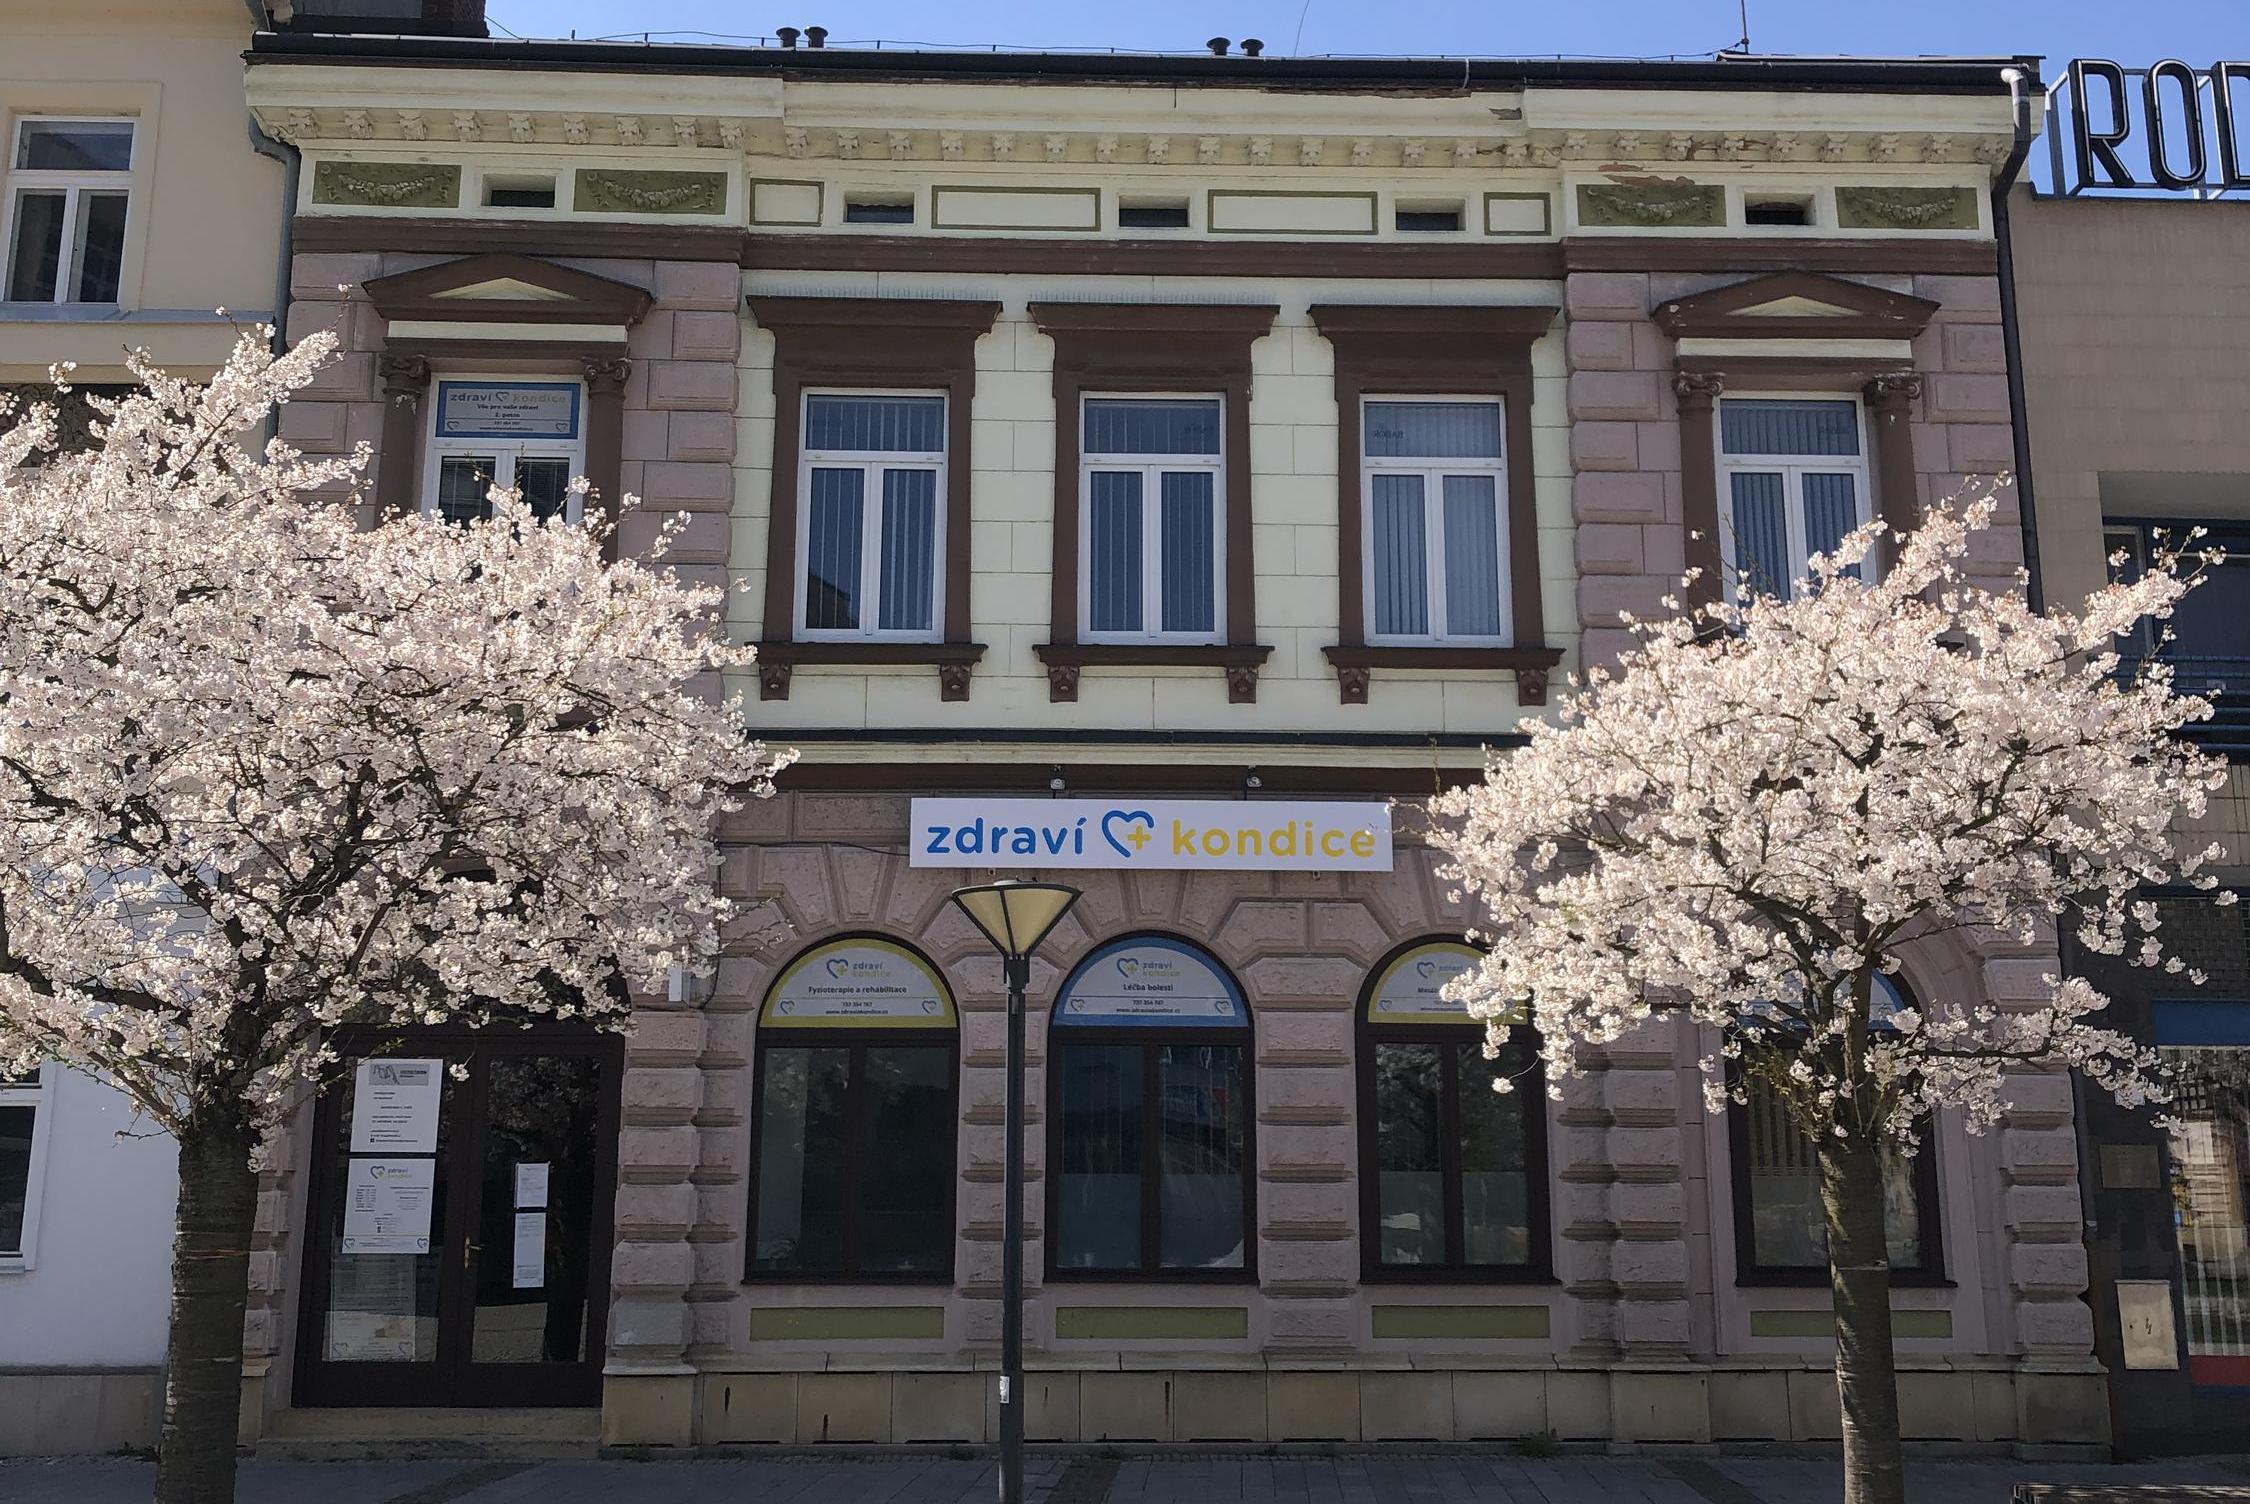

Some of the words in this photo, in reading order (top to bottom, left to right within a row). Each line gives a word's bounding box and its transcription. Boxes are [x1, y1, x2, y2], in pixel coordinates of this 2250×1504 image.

[450, 392, 492, 402] zdraví
[513, 393, 567, 404] kondice
[926, 816, 1088, 855] zdraví
[1172, 819, 1376, 858] kondice
[852, 961, 883, 970] zdraví
[1142, 961, 1173, 969] zdraví
[808, 986, 855, 994] Fyzioterapie
[1123, 983, 1146, 991] Léčba
